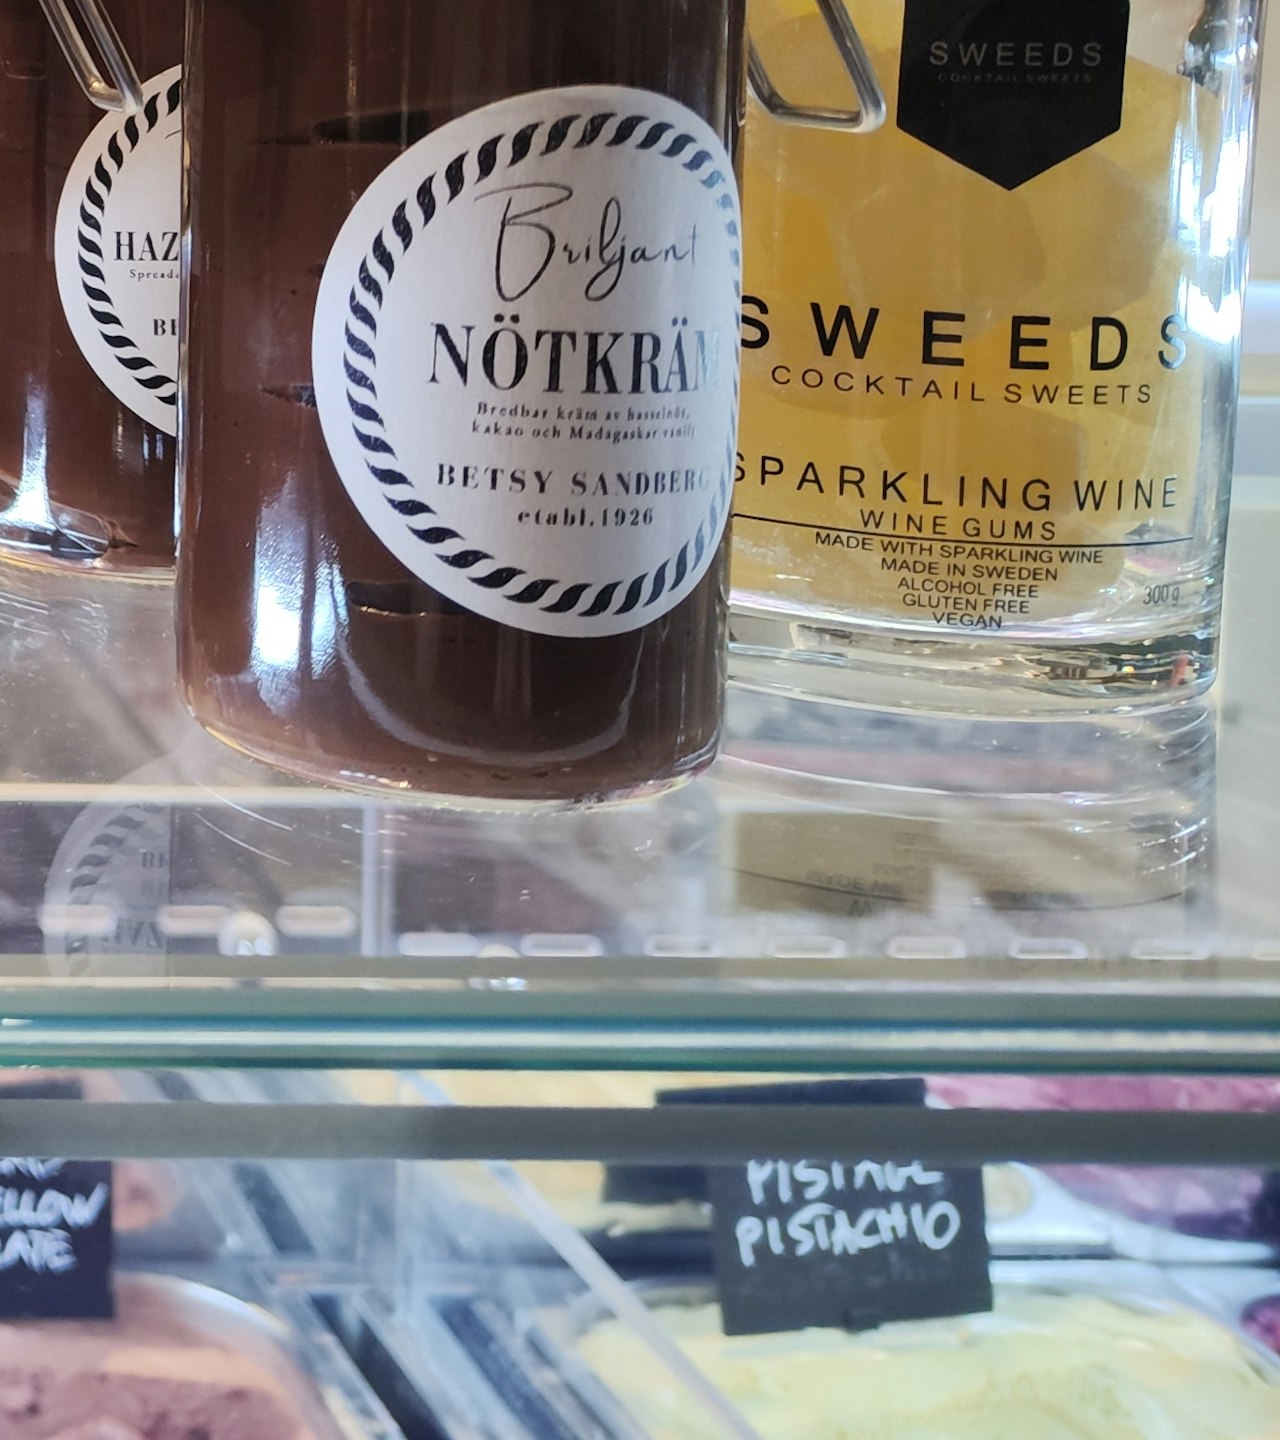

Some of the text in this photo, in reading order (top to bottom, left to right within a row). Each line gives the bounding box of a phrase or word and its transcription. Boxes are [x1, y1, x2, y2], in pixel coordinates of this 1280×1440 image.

[929, 41, 1102, 67] SWEEDS
[474, 182, 701, 303] Briljant
[740, 295, 1186, 371] SWEEDS
[426, 313, 719, 395] NÖTKRÄM
[771, 365, 1152, 405] COCKTAIL SWEETS
[477, 402, 548, 420] Bredbar
[556, 403, 597, 421] kräm
[605, 411, 620, 421] av
[472, 421, 523, 437] kakao
[532, 423, 561, 439] och
[569, 425, 657, 444] Madagaskar
[437, 463, 709, 496] BETSY SANDBERG
[1073, 475, 1178, 512] WINE
[860, 509, 1056, 541] WINE GUMS
[815, 531, 1103, 564] MADE WITH SPARKLING WINE
[881, 558, 1058, 581] MADE IN SWEDEN
[897, 577, 1039, 598] ALCOHOL FREE
[902, 593, 1030, 614] GLUTEN FREE
[933, 612, 1002, 628] VEGAN
[735, 1200, 961, 1267] PISTACHIO
